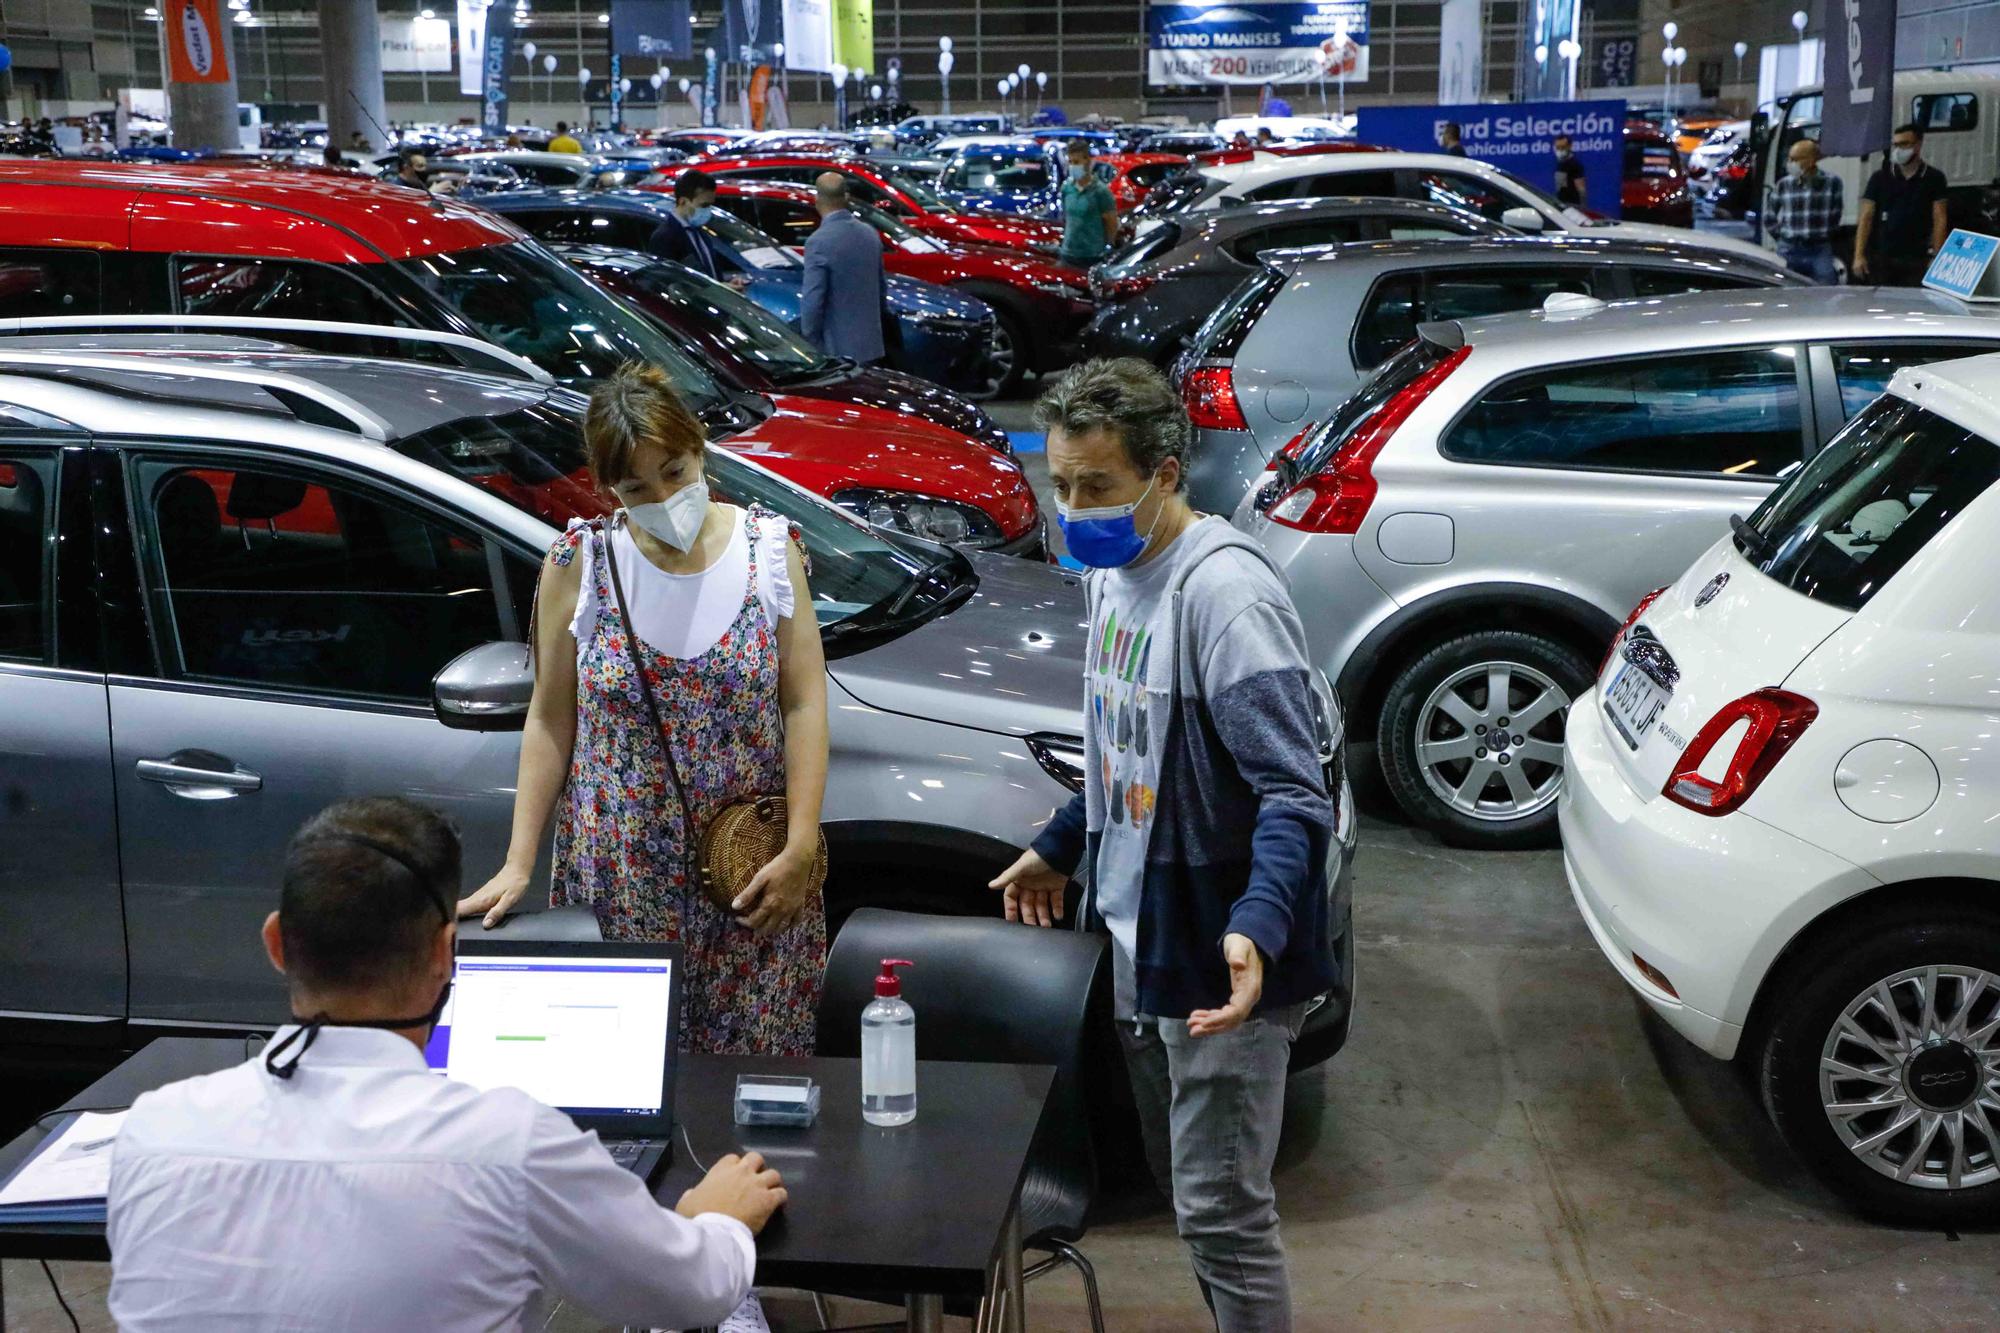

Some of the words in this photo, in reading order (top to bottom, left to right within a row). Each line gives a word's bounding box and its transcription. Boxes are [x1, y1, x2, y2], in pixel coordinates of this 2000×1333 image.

[1160, 33, 1210, 47] TURBO
[1213, 32, 1282, 46] MANISES
[1210, 57, 1247, 75] 200
[483, 36, 507, 127] SPOTICAR
[1494, 112, 1615, 138] Selección
[1464, 141, 1529, 157] ehículos
[1531, 139, 1551, 154] de
